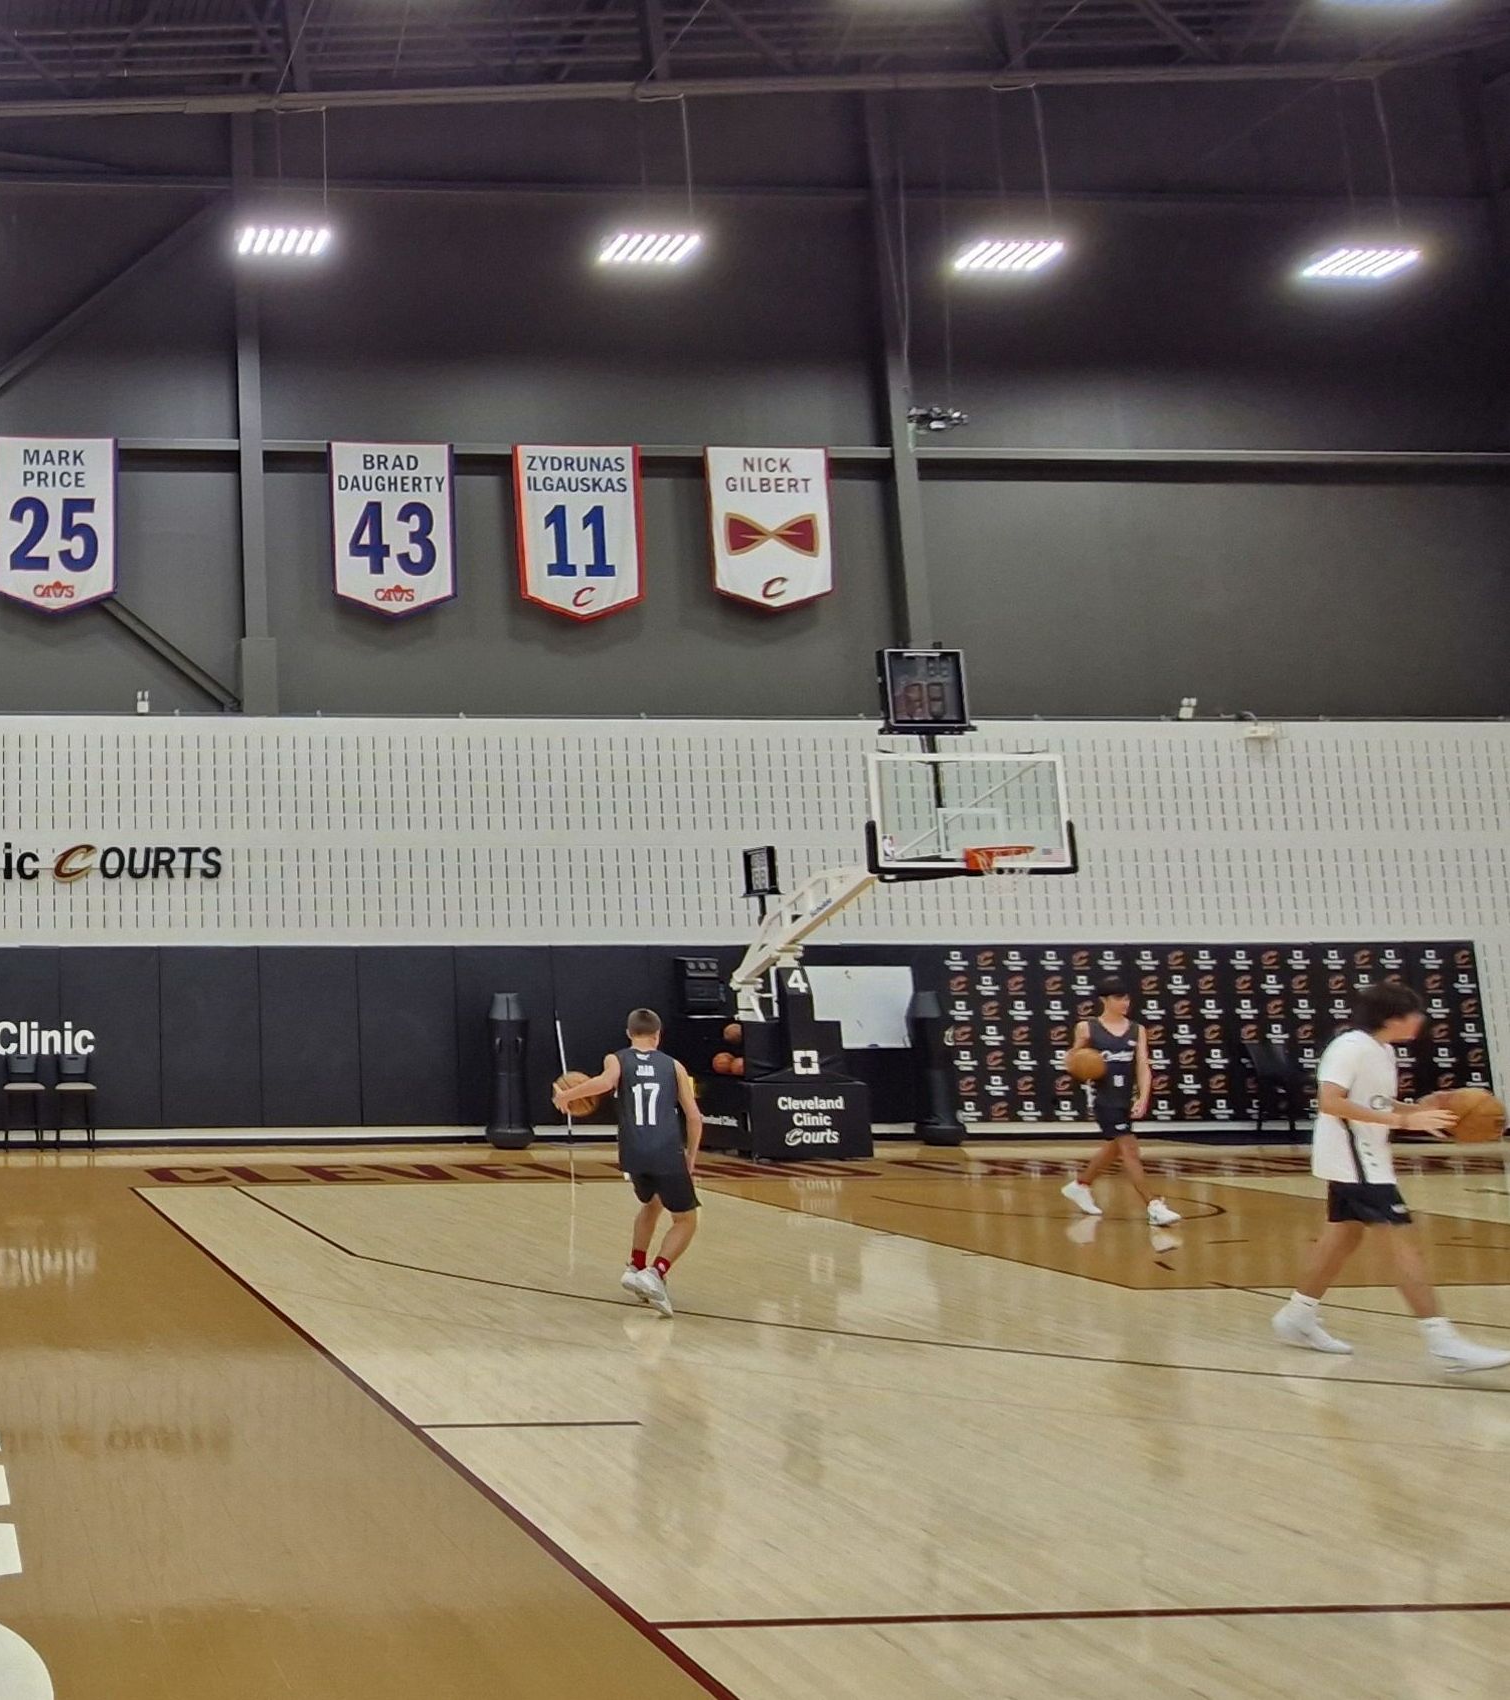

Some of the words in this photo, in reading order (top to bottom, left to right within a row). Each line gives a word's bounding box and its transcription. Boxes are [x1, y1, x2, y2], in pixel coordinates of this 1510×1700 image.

[23, 448, 85, 467] MARK
[362, 453, 419, 471] BRAD
[526, 455, 626, 473] ZYDRUNAS
[742, 456, 792, 473] NICK
[22, 470, 86, 488] PRICE
[337, 474, 445, 494] DAUGHERTY
[526, 476, 628, 494] ILGAUSKAS
[725, 476, 812, 494] GILBERT
[9, 496, 99, 573] 25
[348, 500, 437, 577] 43
[544, 504, 616, 577] 11
[32, 581, 75, 599] CAVS
[374, 584, 415, 603] CAVS
[787, 969, 809, 994] 4
[631, 1082, 661, 1126] 17
[777, 1095, 845, 1111] Cleveland
[792, 1111, 833, 1127] Clinic
[784, 1128, 840, 1147] Courts
